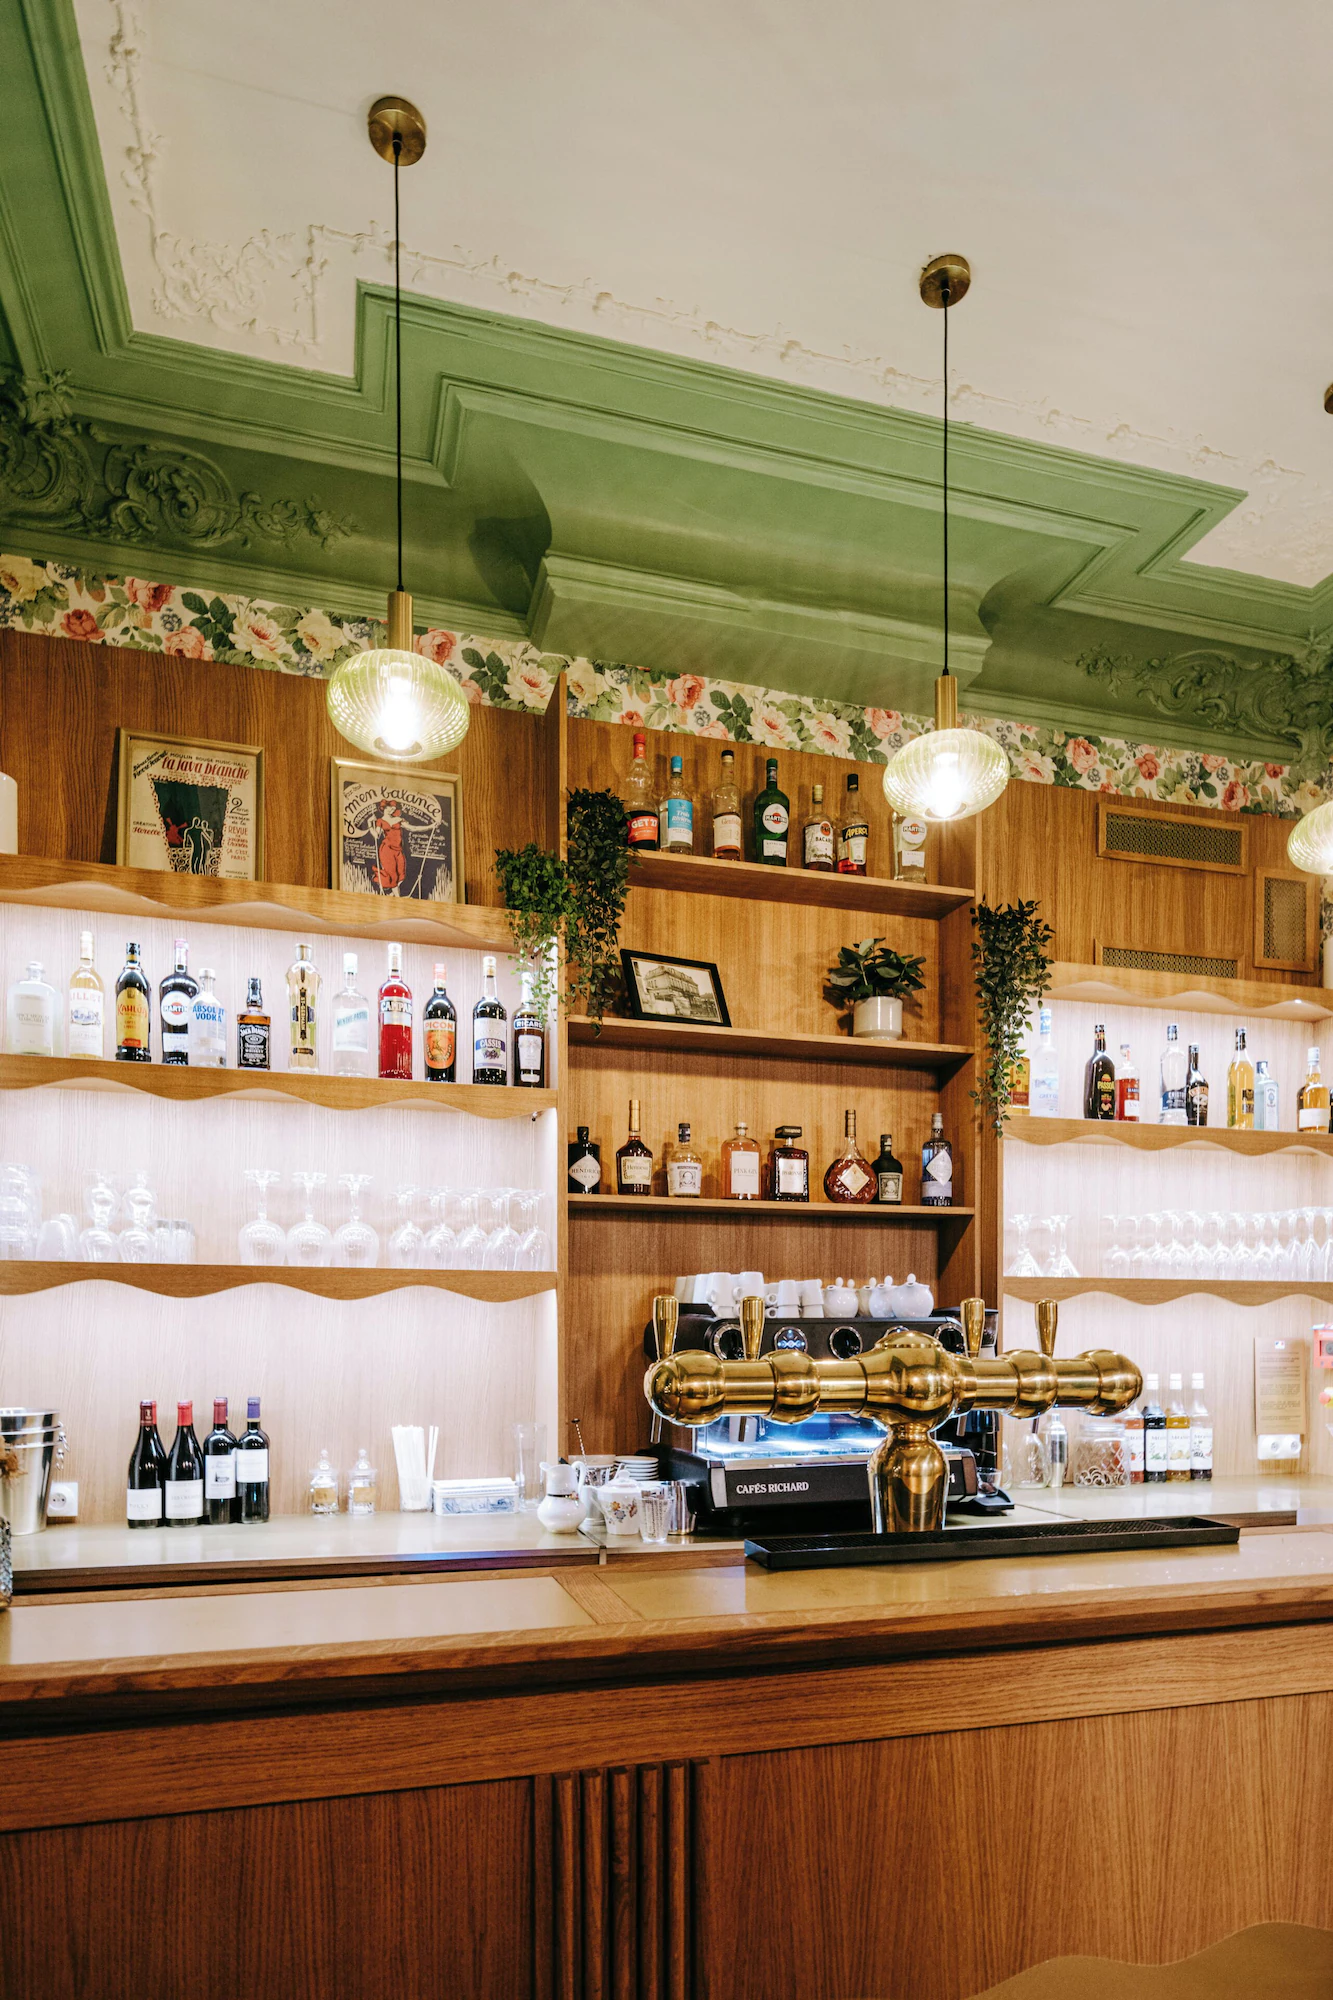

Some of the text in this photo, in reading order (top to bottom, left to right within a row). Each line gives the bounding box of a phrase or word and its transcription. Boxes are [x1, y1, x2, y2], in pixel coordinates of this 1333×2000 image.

[204, 763, 250, 780] blanche
[380, 786, 441, 817] balance
[631, 819, 648, 829] GET
[765, 814, 788, 824] MARTINI
[228, 826, 248, 836] REVUE
[846, 827, 868, 839] APEROL
[163, 1005, 188, 1013] MARTIN
[381, 1000, 413, 1012] CAMPAR
[195, 1013, 222, 1022] VODKA
[425, 1021, 454, 1030] PICON
[480, 1038, 502, 1049] CASSIS
[736, 1481, 809, 1494] CAFÉS RICHARD
